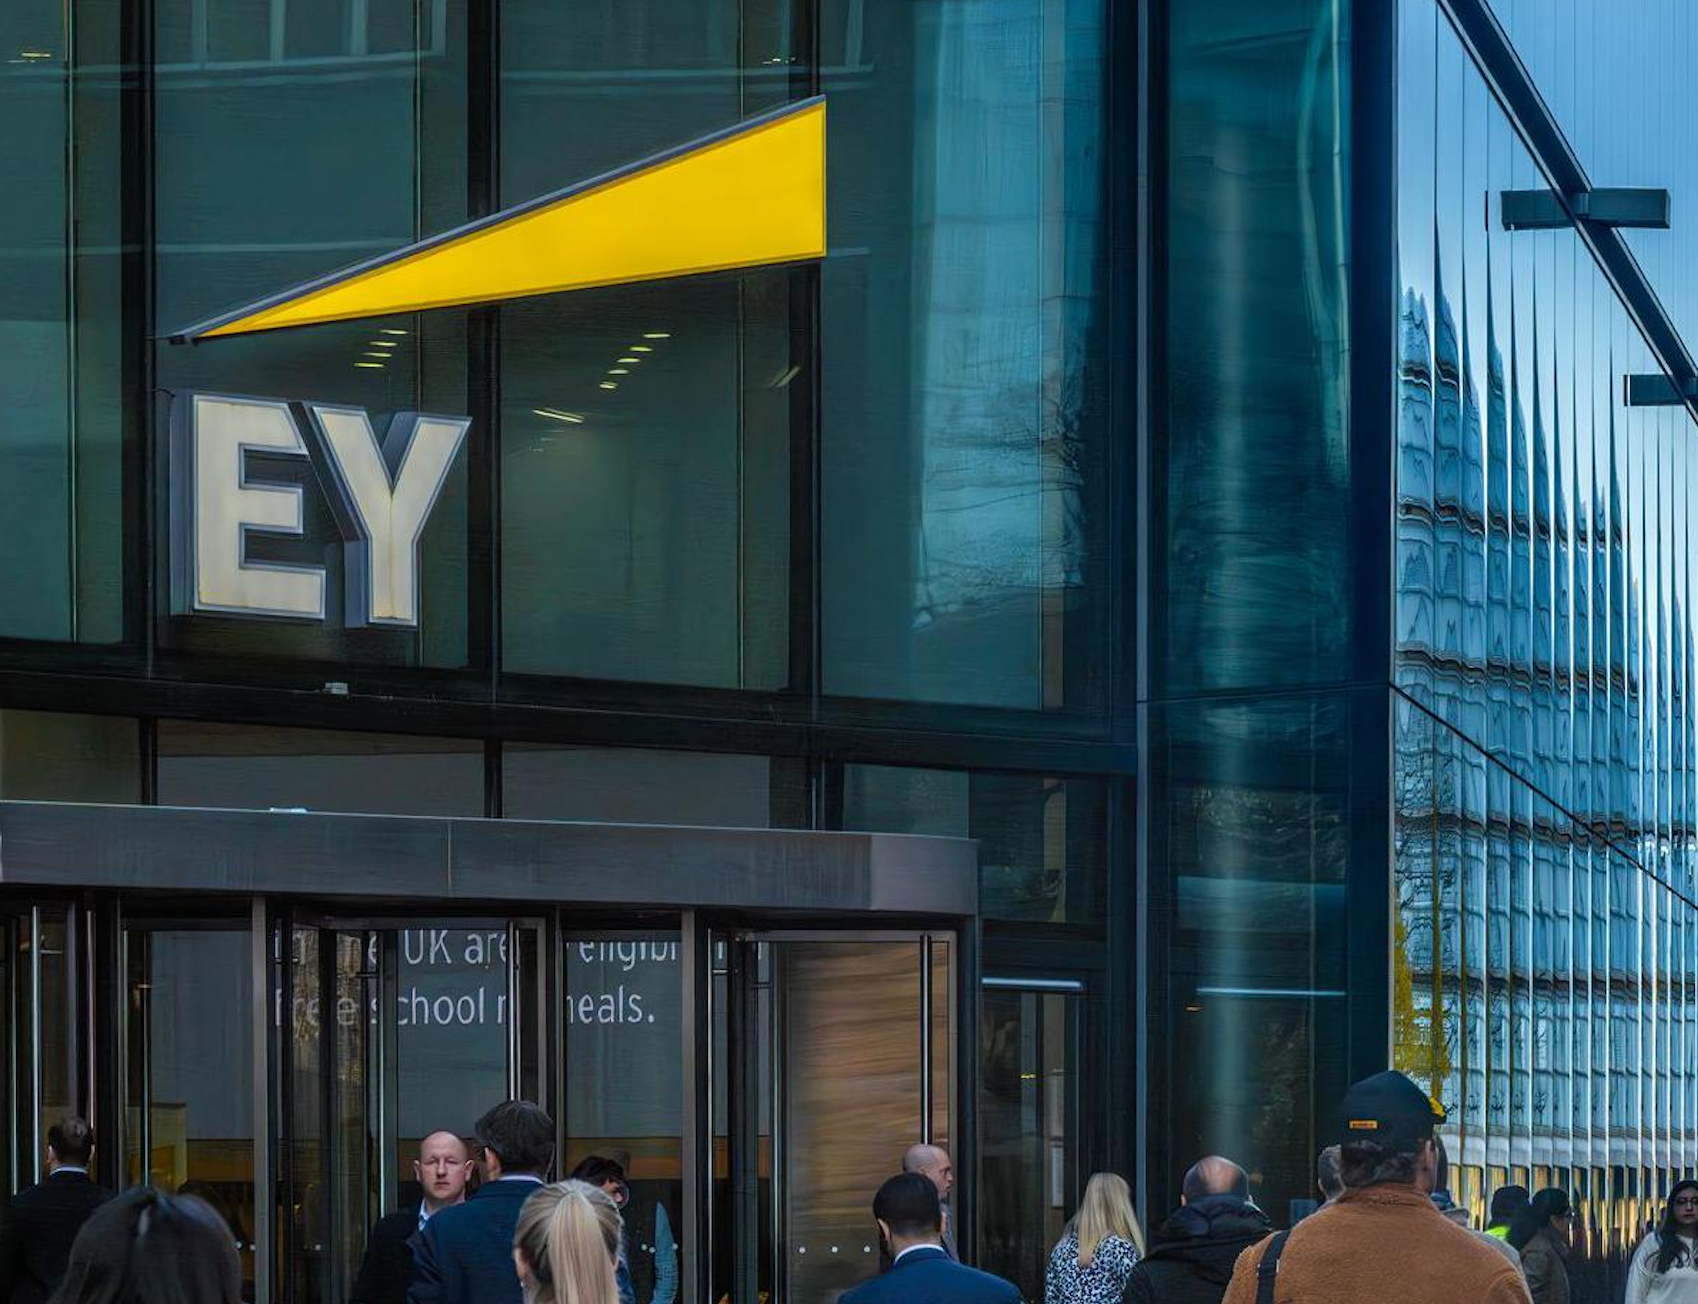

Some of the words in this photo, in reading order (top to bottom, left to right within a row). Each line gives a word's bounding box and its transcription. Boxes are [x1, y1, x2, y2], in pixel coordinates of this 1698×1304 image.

[192, 393, 472, 627] EY
[404, 930, 451, 965] UK
[579, 941, 677, 971] eligibl
